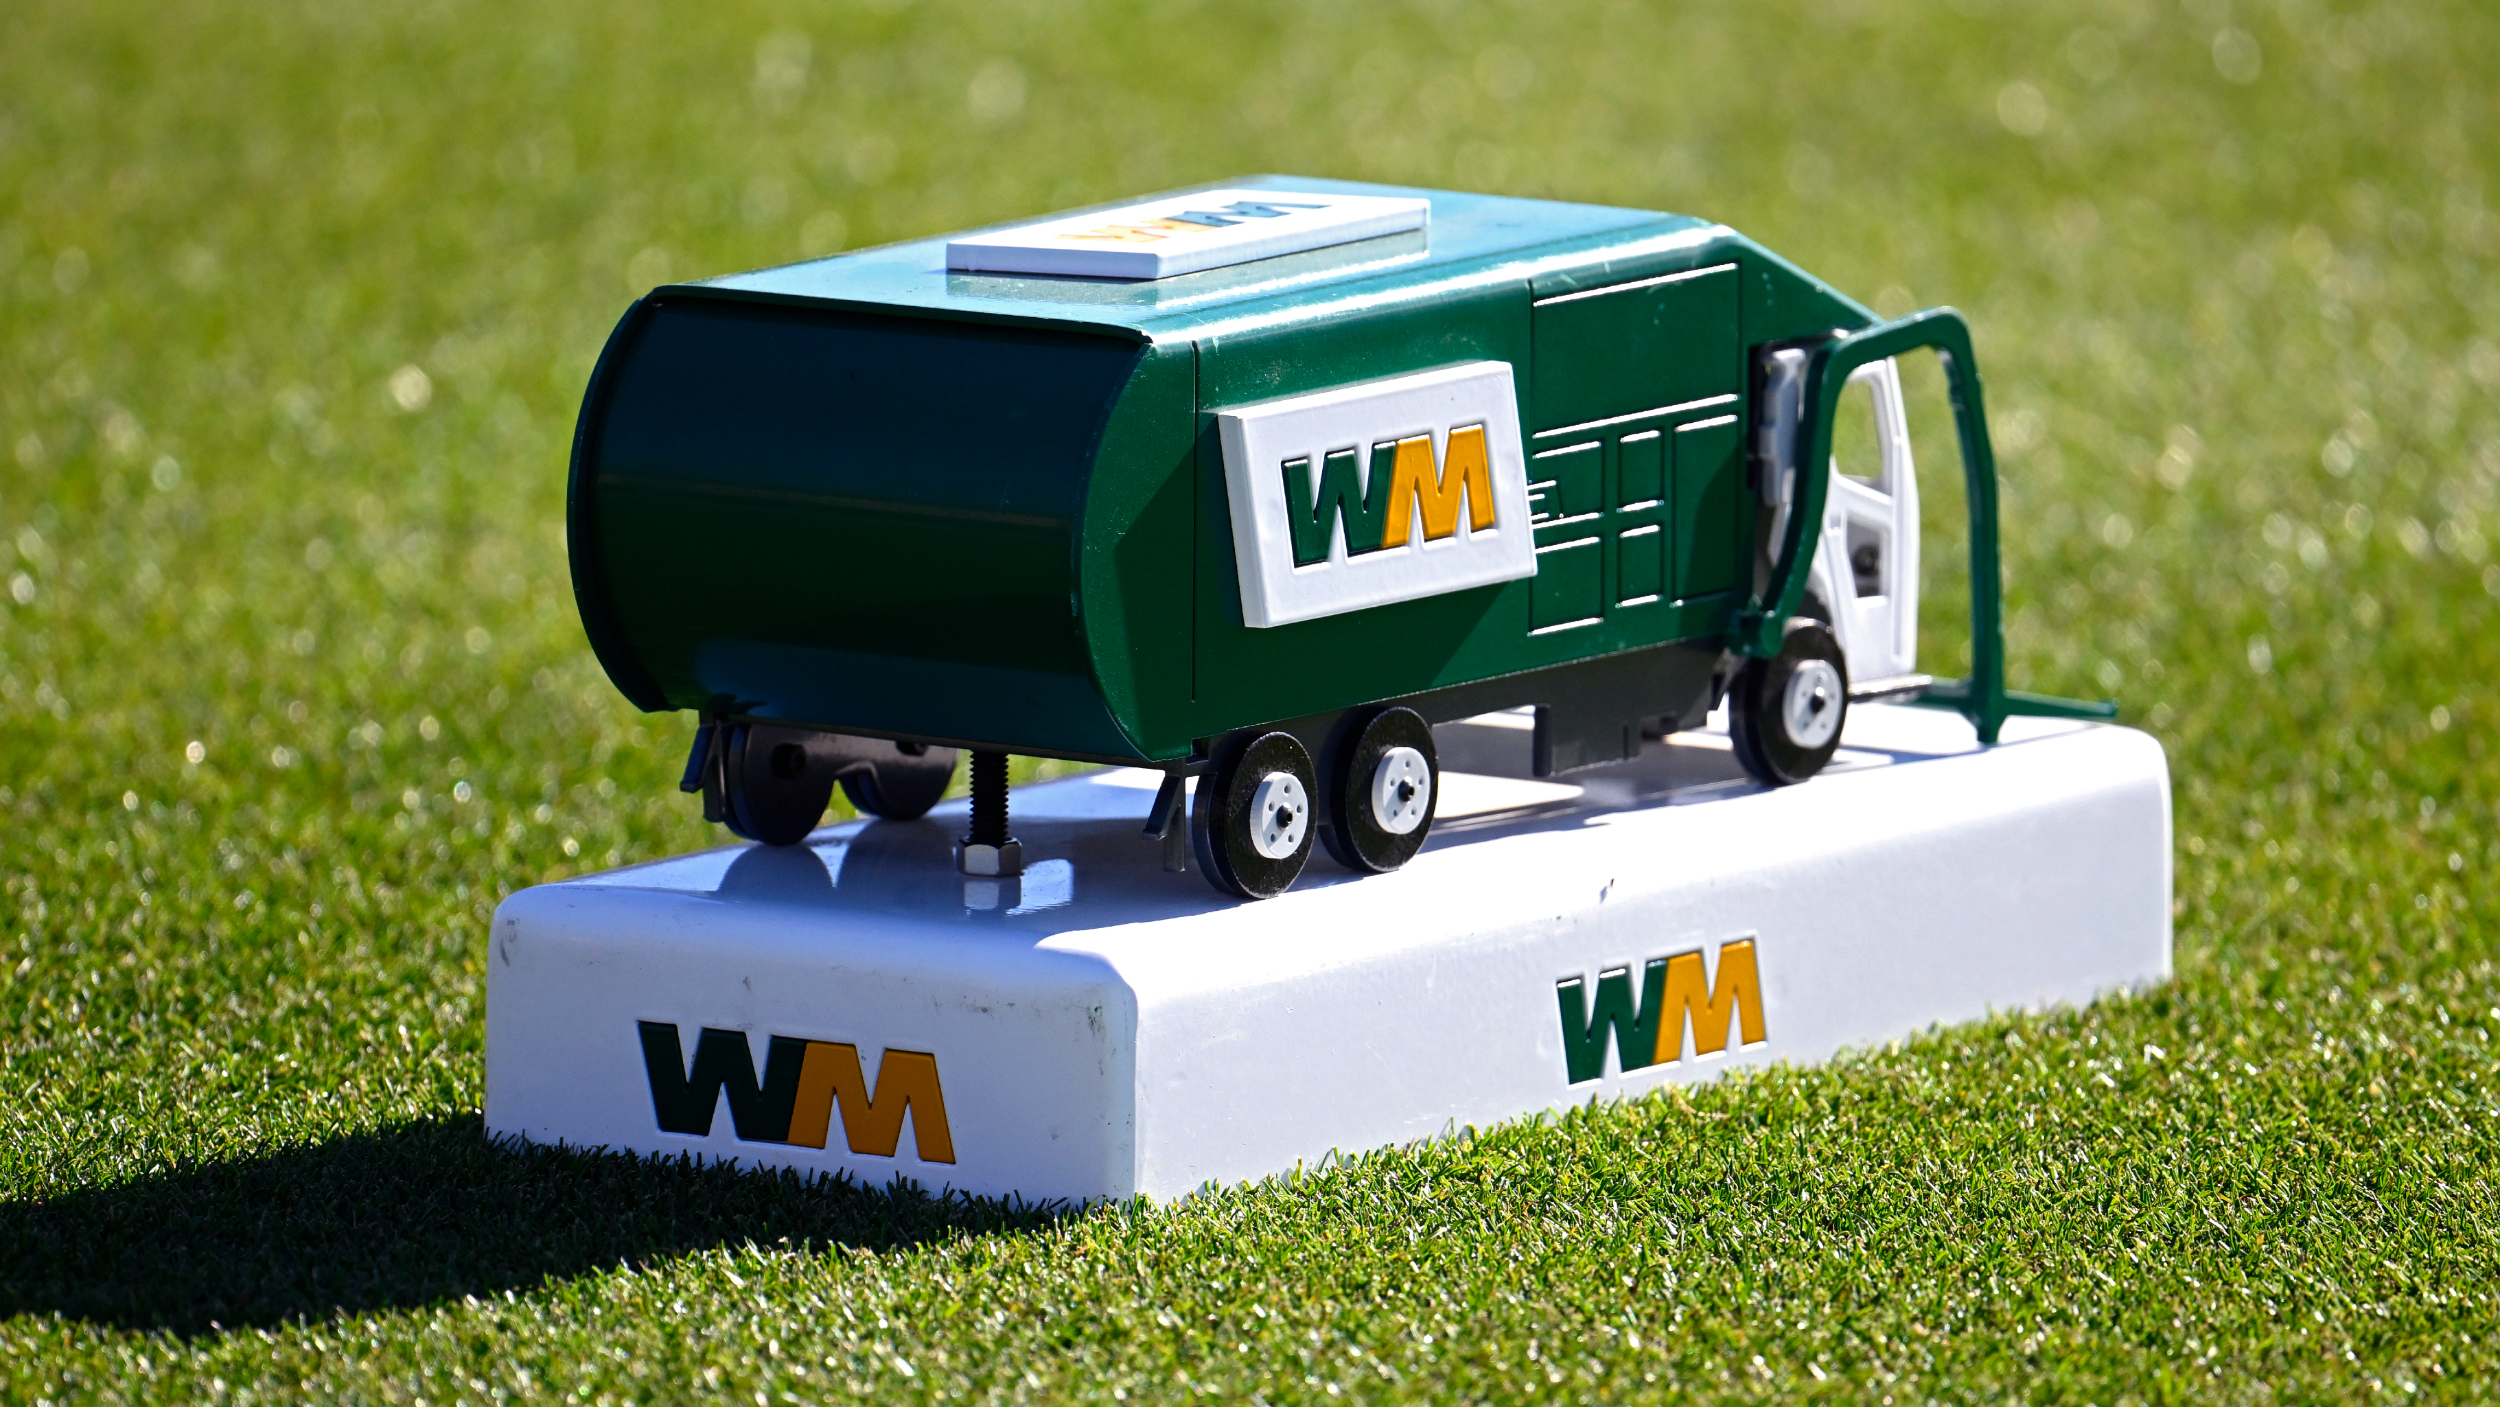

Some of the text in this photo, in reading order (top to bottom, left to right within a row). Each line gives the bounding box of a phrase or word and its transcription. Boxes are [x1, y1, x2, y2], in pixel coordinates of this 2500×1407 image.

[1281, 423, 1496, 568] WM
[1556, 937, 1767, 1086] WM
[637, 1020, 956, 1165] WM
